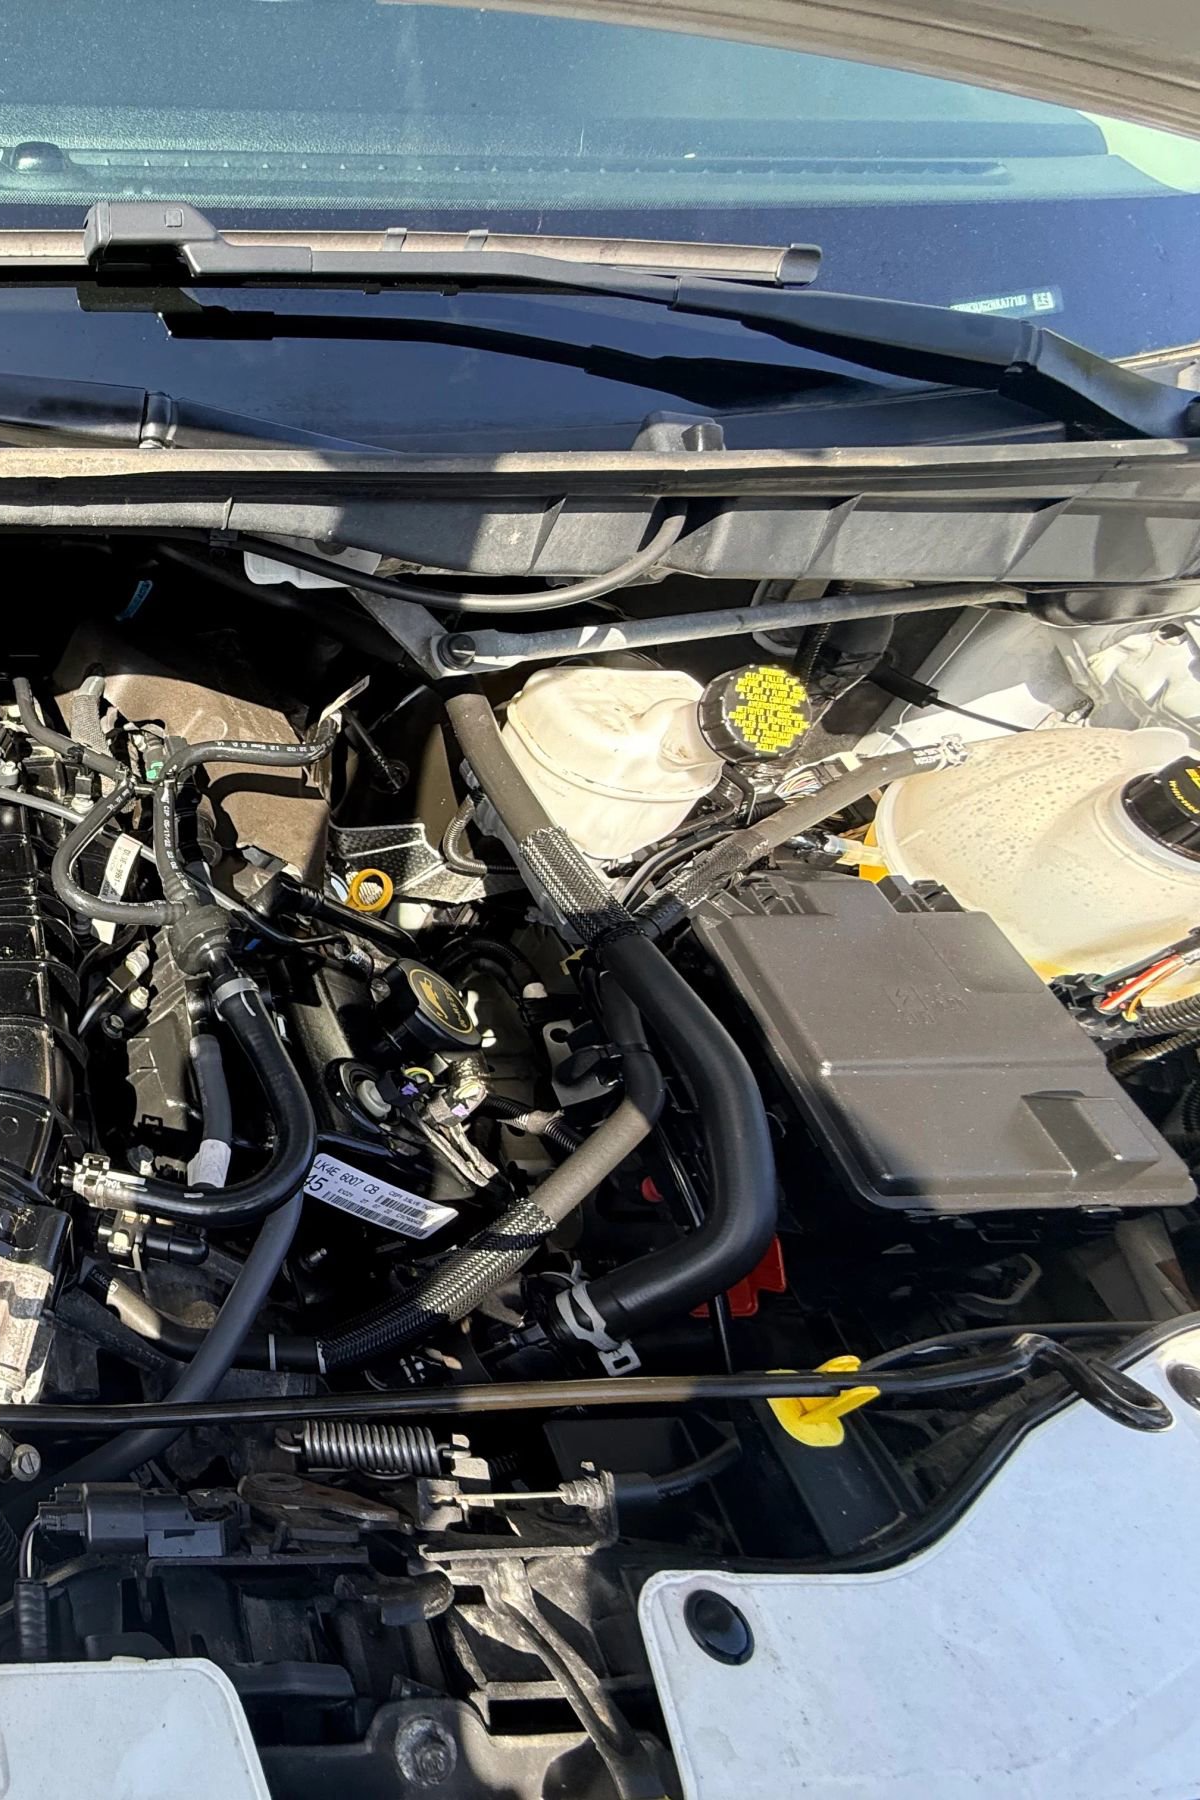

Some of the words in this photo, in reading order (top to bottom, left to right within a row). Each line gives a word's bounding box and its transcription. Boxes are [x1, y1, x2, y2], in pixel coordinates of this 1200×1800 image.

[313, 1159, 340, 1177] LK4E
[340, 1172, 364, 1188] 6007
[363, 1183, 380, 1195] CB
